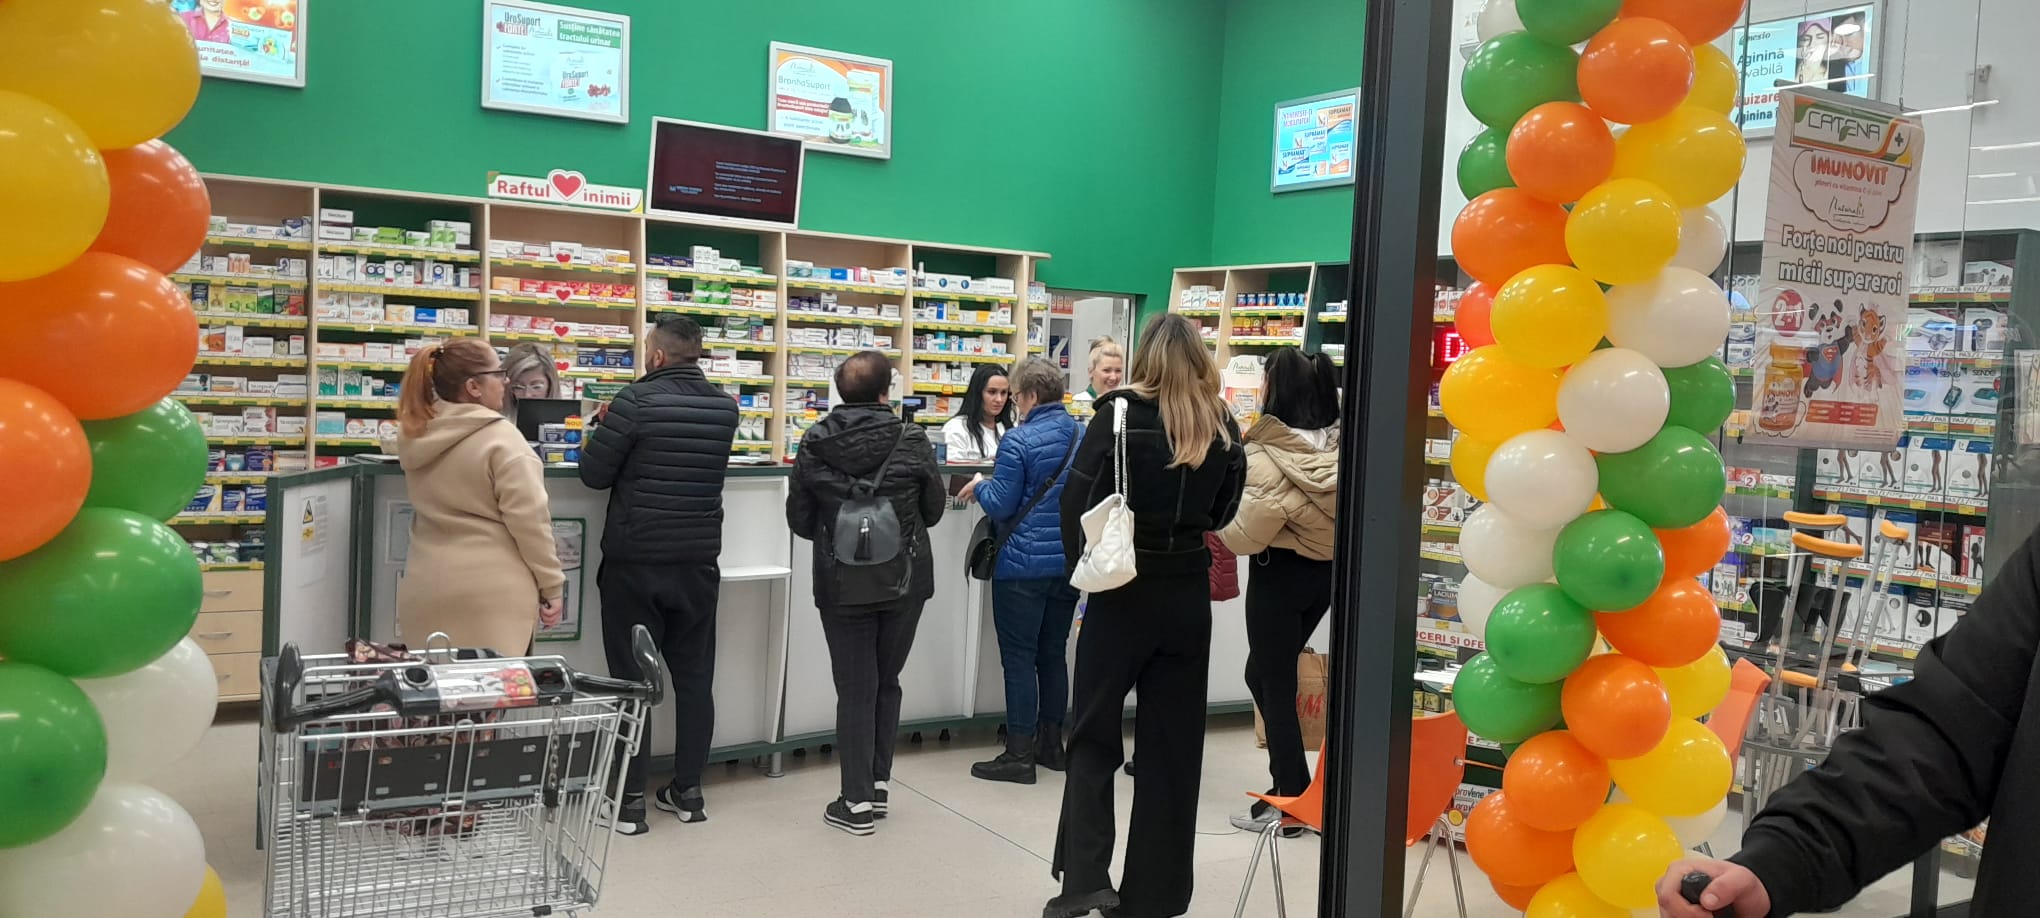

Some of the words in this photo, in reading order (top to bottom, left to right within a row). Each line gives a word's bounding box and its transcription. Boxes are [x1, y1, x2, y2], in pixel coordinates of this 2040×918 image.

[504, 11, 541, 27] UroSuport
[590, 37, 611, 46] urinar
[1808, 110, 1880, 142] CATENA
[1811, 154, 1889, 186] IMUNOVIT
[497, 180, 550, 198] Raftul
[583, 188, 631, 206] inimii
[1781, 224, 1826, 257] Forțe
[1827, 233, 1853, 256] noi
[1853, 237, 1904, 263] pentru
[1778, 258, 1823, 285] micii
[1823, 268, 1903, 296] supereroi
[1746, 477, 1754, 486] 2
[1744, 534, 1752, 544] 2
[1449, 635, 1460, 645] SI
